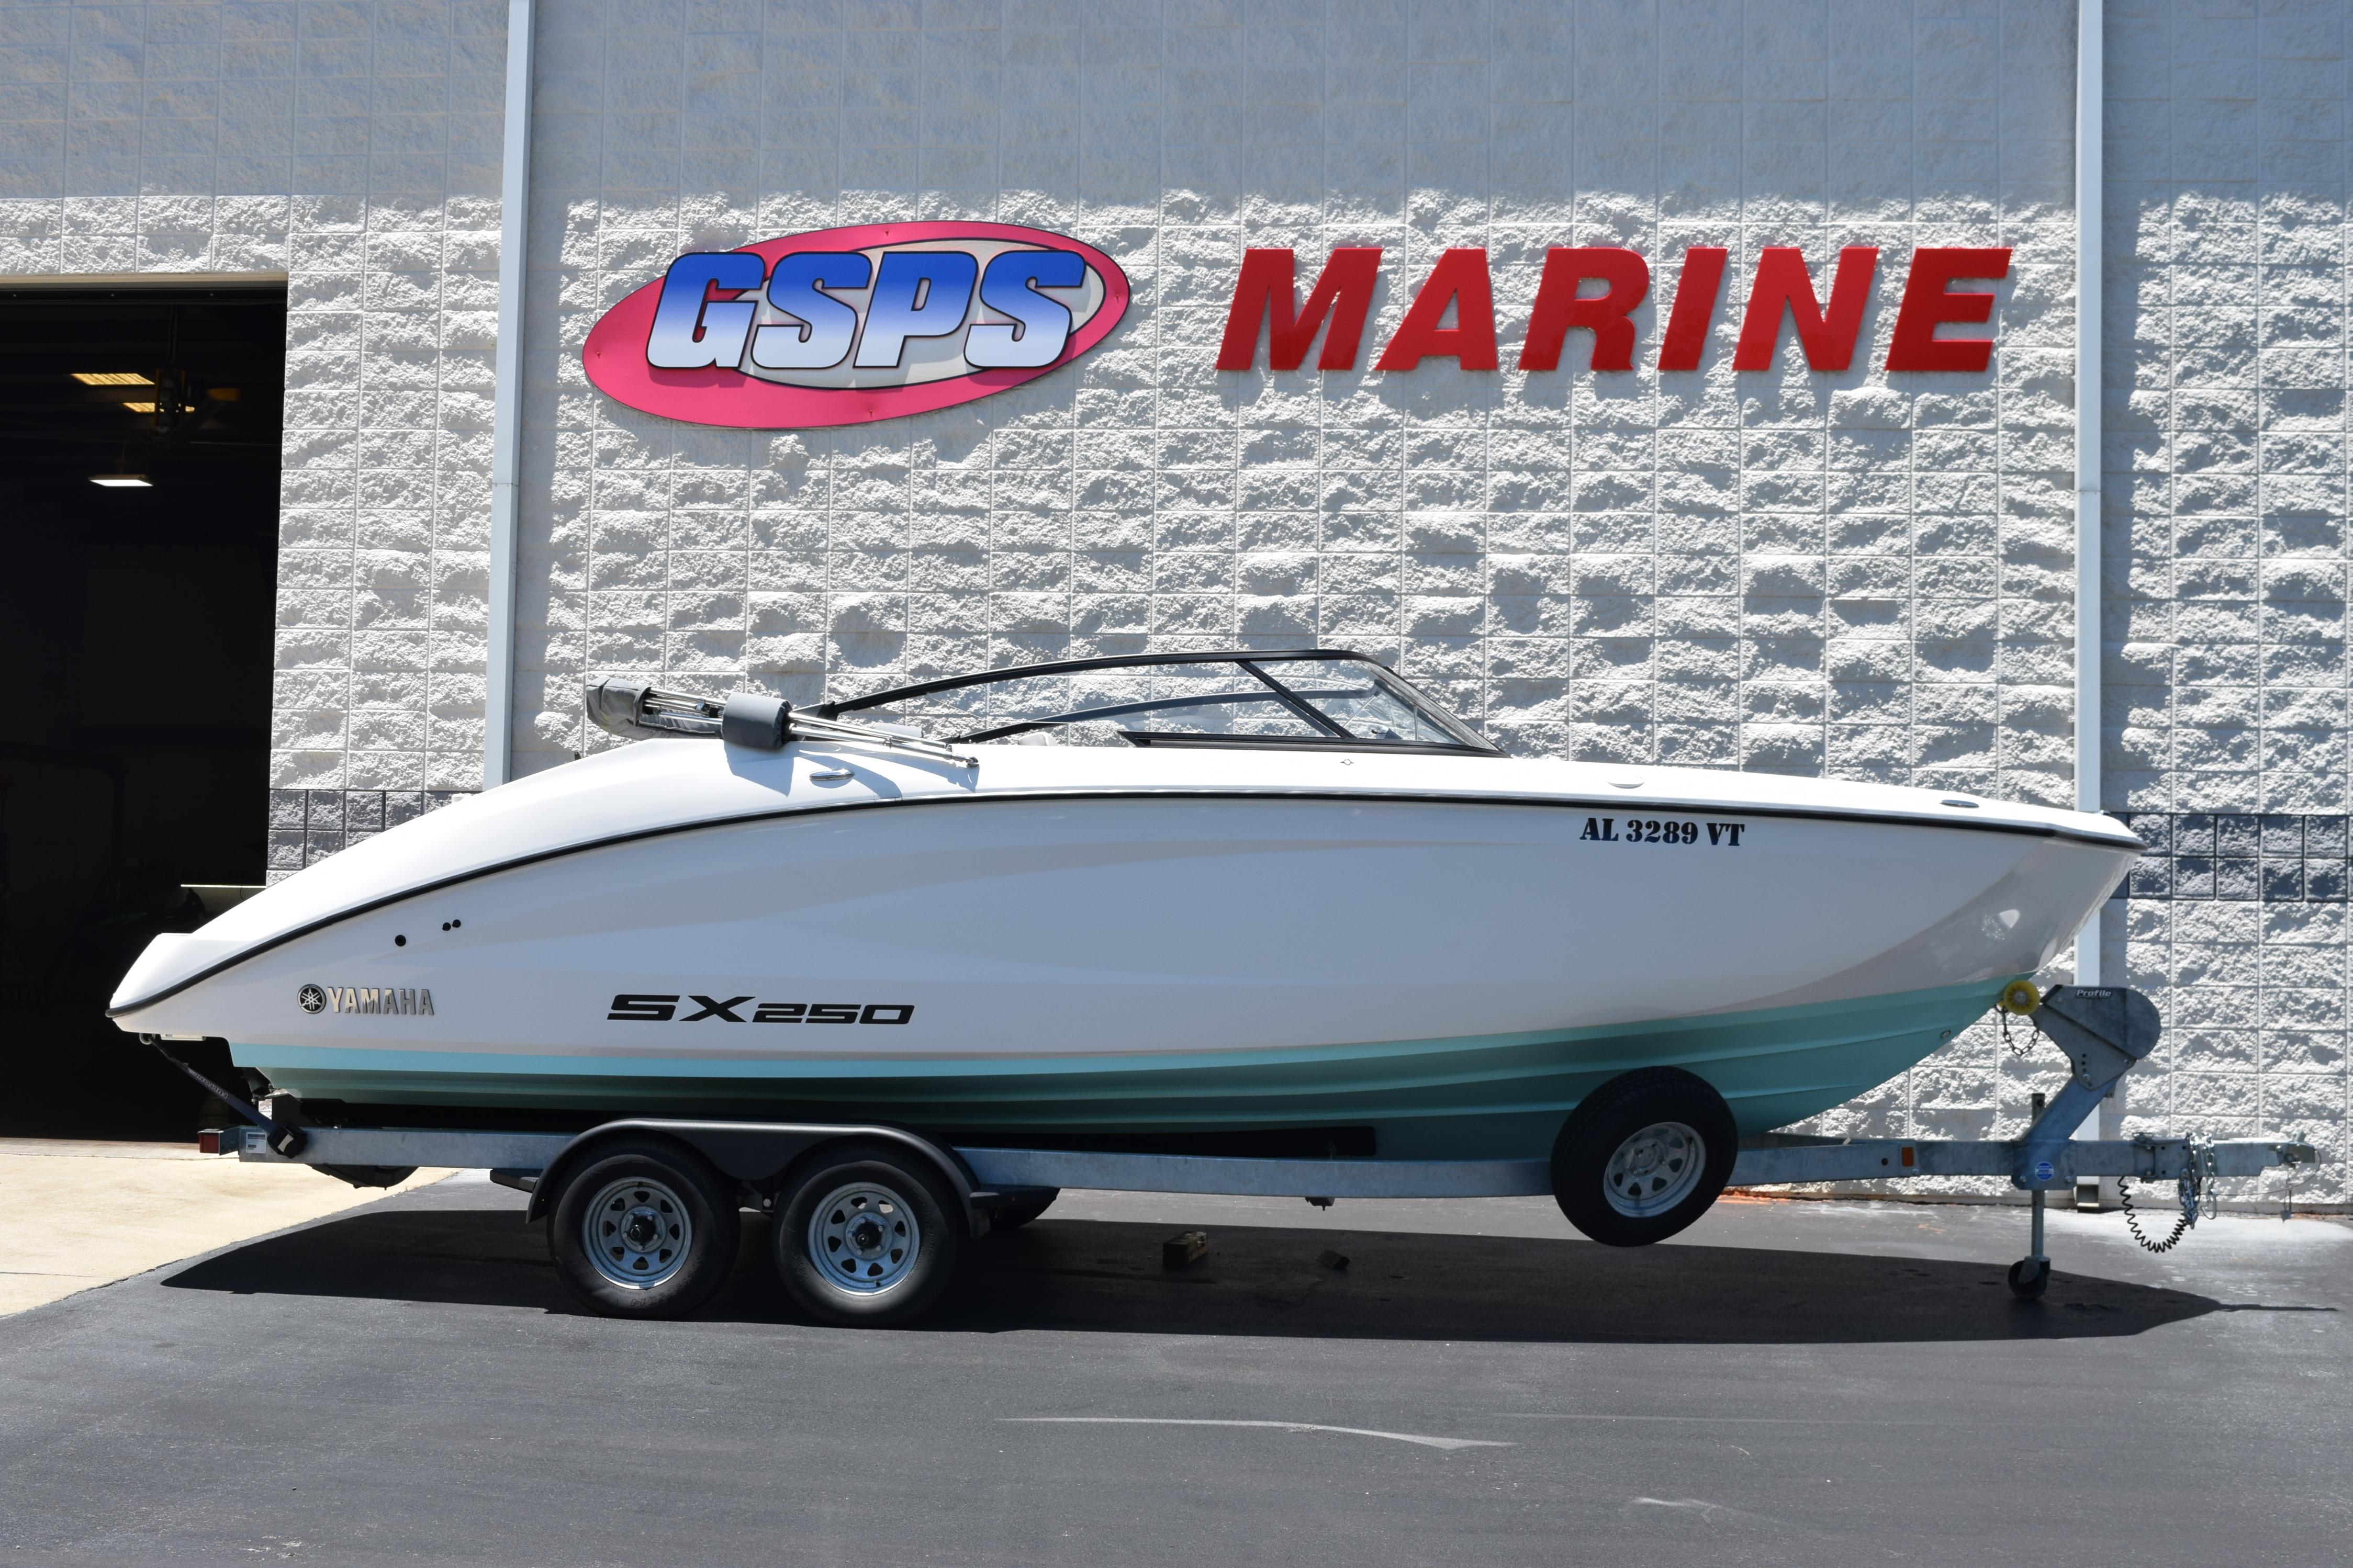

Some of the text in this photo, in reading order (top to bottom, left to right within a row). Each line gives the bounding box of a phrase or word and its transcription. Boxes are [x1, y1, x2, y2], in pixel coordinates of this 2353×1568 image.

[646, 247, 2012, 372] GSPS MARINE
[1579, 818, 1745, 846] AL 3289 VT
[327, 987, 434, 1016] YAMAHA
[607, 994, 915, 1024] SX250
